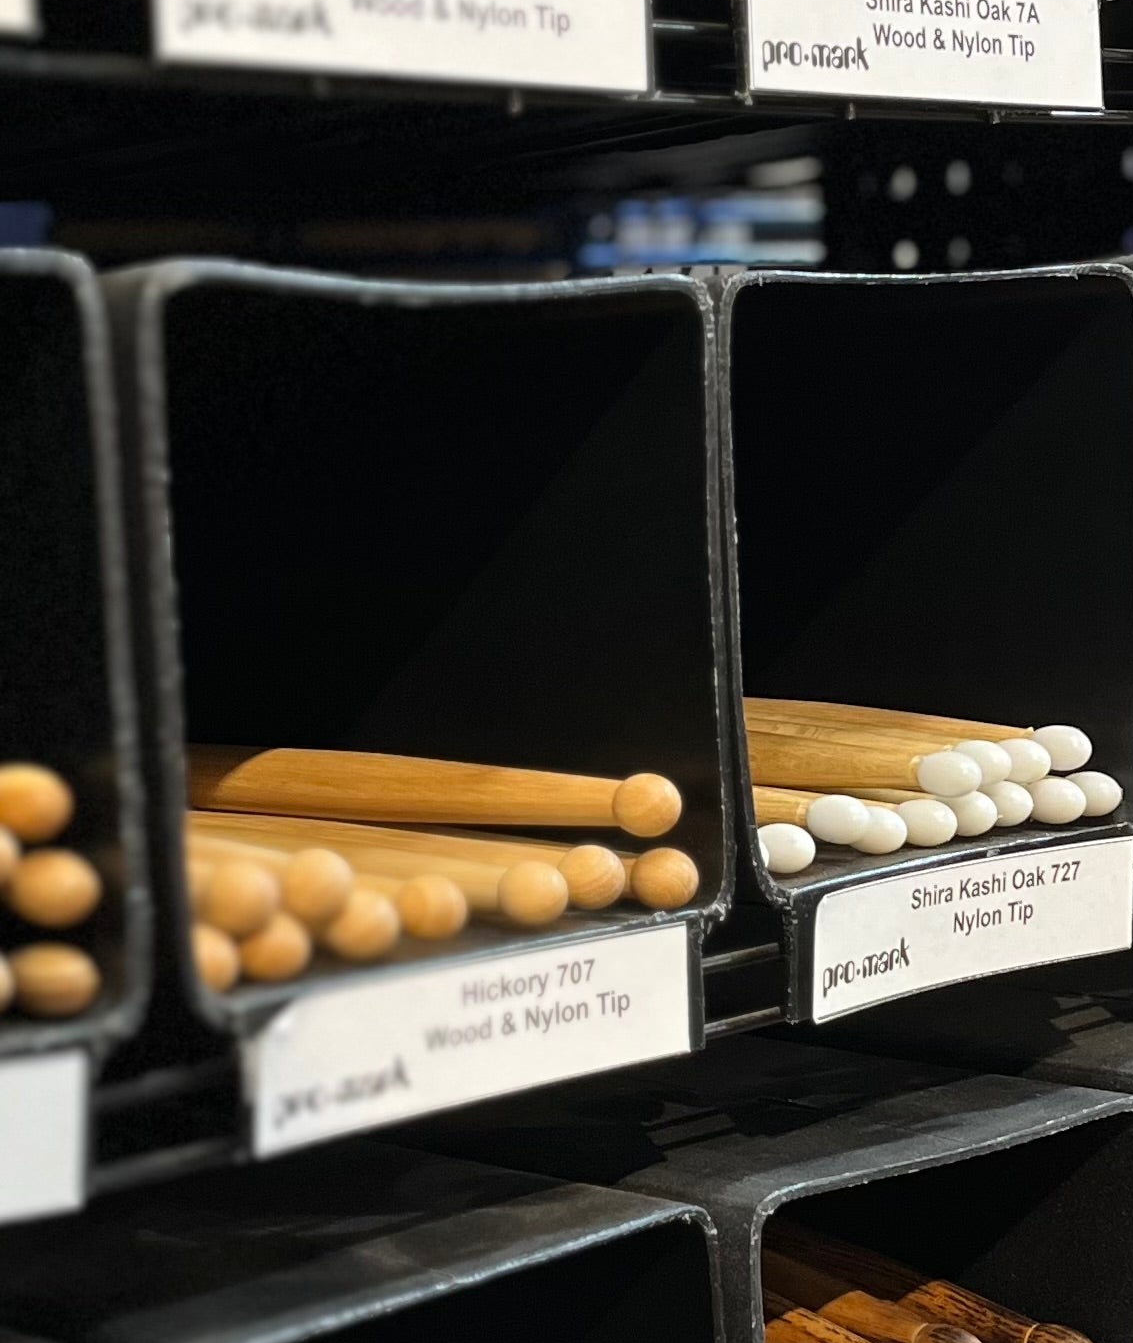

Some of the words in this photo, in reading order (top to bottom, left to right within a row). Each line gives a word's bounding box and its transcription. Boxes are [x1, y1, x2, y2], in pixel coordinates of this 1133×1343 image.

[534, 5, 572, 38] Tip
[1015, 3, 1041, 25] 7A
[873, 23, 926, 50] Wood
[933, 28, 946, 51] &
[952, 29, 1002, 59] Nylon
[1008, 34, 1035, 62] Tip
[911, 884, 954, 911] Shira
[958, 872, 1007, 901] Kashi
[1012, 865, 1046, 891] Oak
[1051, 860, 1081, 884] 727
[953, 906, 1001, 937] Nylon
[1007, 900, 1034, 924] Tip
[460, 969, 550, 1009] Hickory
[557, 959, 596, 988] 707
[425, 1016, 492, 1053] Wood
[501, 1012, 517, 1037] &
[525, 998, 589, 1035] Nylon
[597, 990, 631, 1019] Tip
